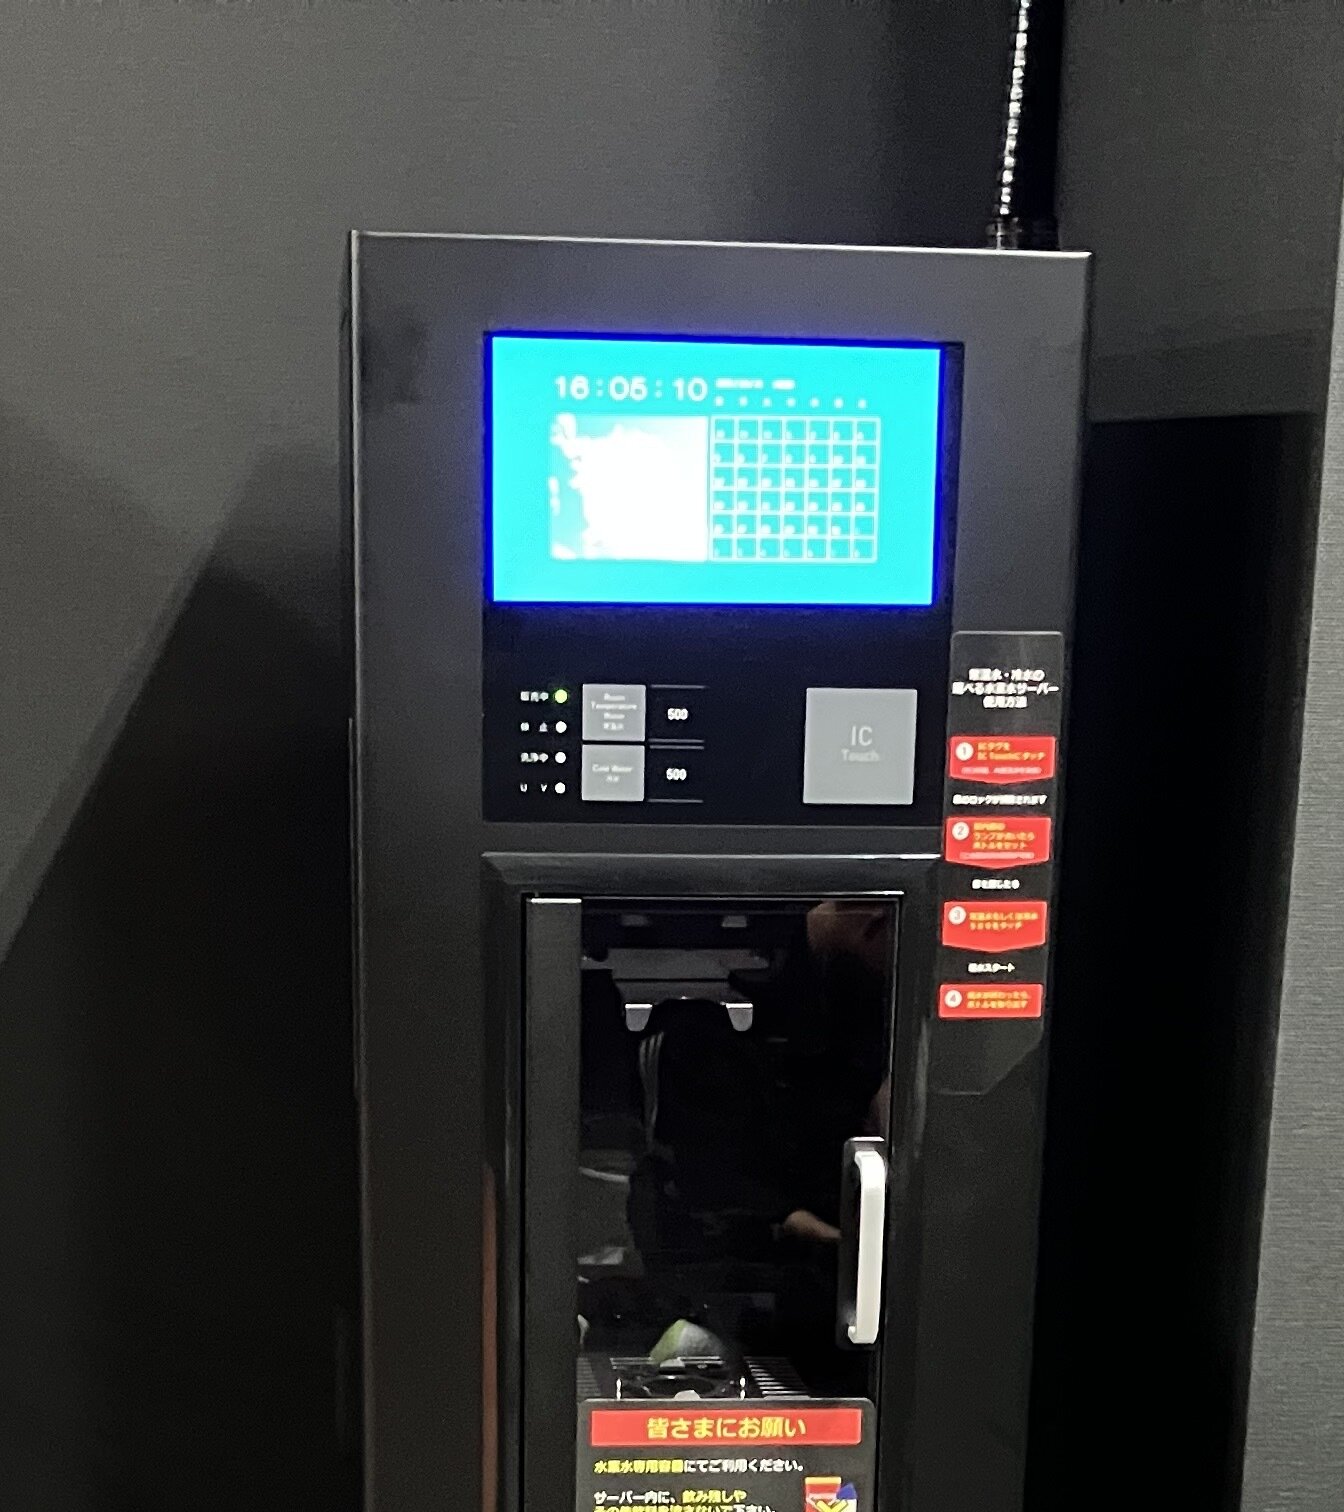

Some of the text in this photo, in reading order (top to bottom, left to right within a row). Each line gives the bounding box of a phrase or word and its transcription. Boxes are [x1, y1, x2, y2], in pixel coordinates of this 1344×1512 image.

[667, 708, 688, 721] 500
[851, 725, 873, 746] IC
[666, 768, 687, 781] 500
[647, 1416, 806, 1439] 皆さまにお願い
